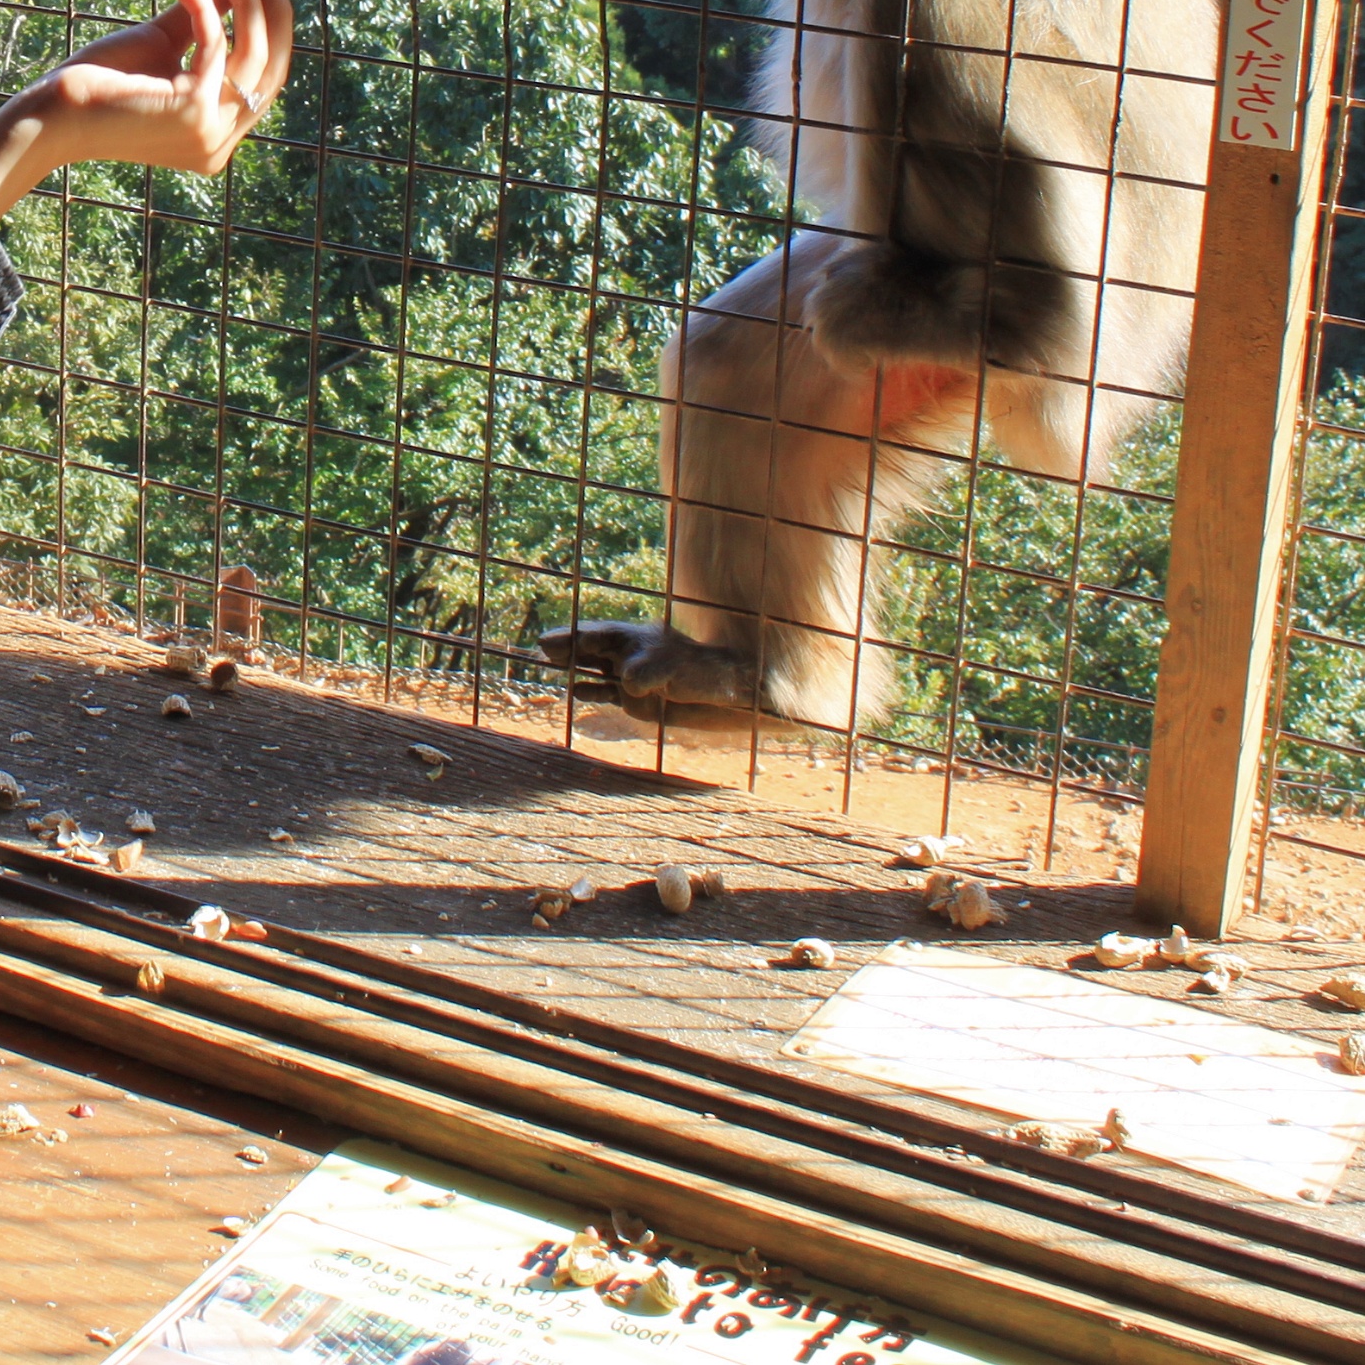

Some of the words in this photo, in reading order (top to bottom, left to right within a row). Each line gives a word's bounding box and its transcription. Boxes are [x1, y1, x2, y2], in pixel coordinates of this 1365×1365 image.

[309, 1258, 349, 1279] Some
[362, 1275, 402, 1297] food
[408, 1294, 430, 1305] on
[441, 1303, 470, 1320] the
[332, 1248, 553, 1331] 手のひらにエサをのせる
[467, 1331, 509, 1348] your
[610, 1315, 680, 1346] Good!
